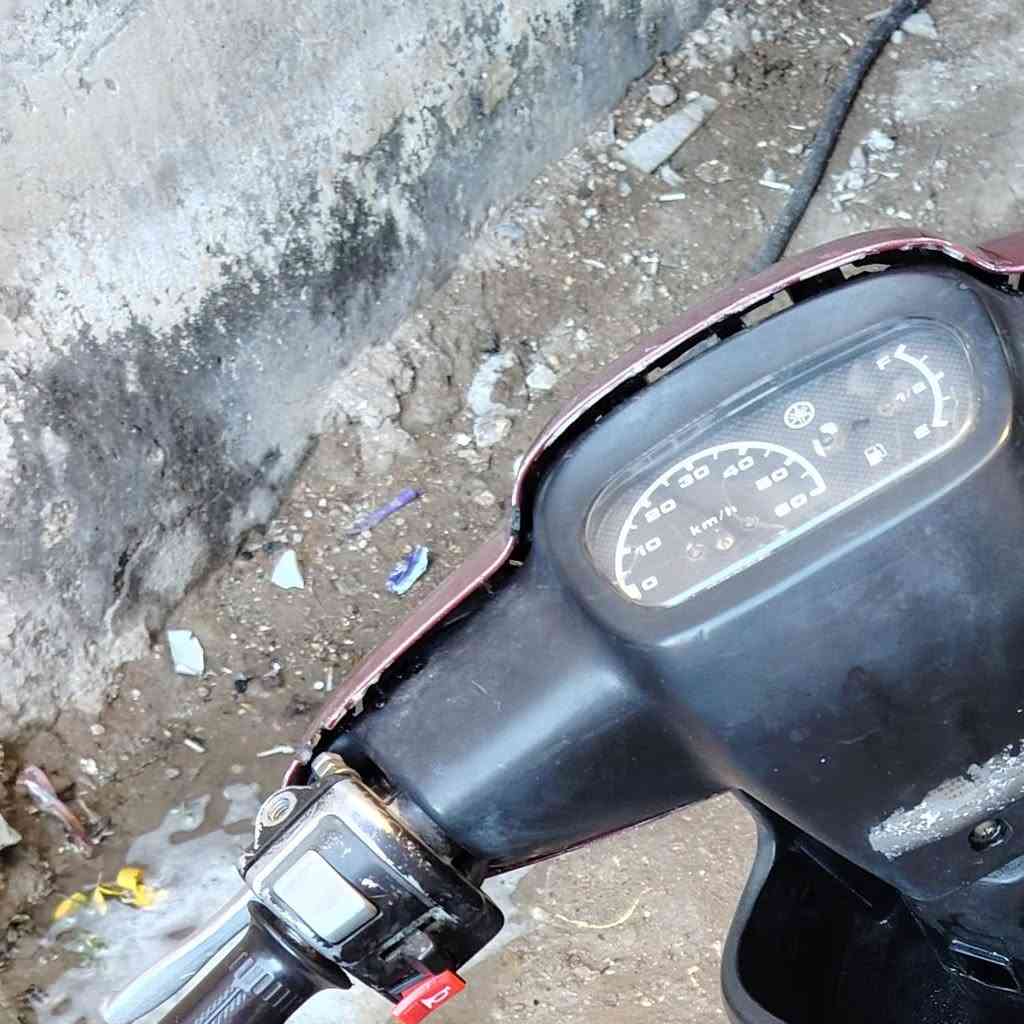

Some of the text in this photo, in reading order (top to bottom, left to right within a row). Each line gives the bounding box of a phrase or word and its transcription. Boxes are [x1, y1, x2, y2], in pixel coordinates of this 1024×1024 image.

[678, 465, 710, 489] 30
[723, 456, 754, 478] 40
[690, 505, 738, 537] km/h
[635, 537, 662, 557] 10
[641, 576, 658, 591] 0
